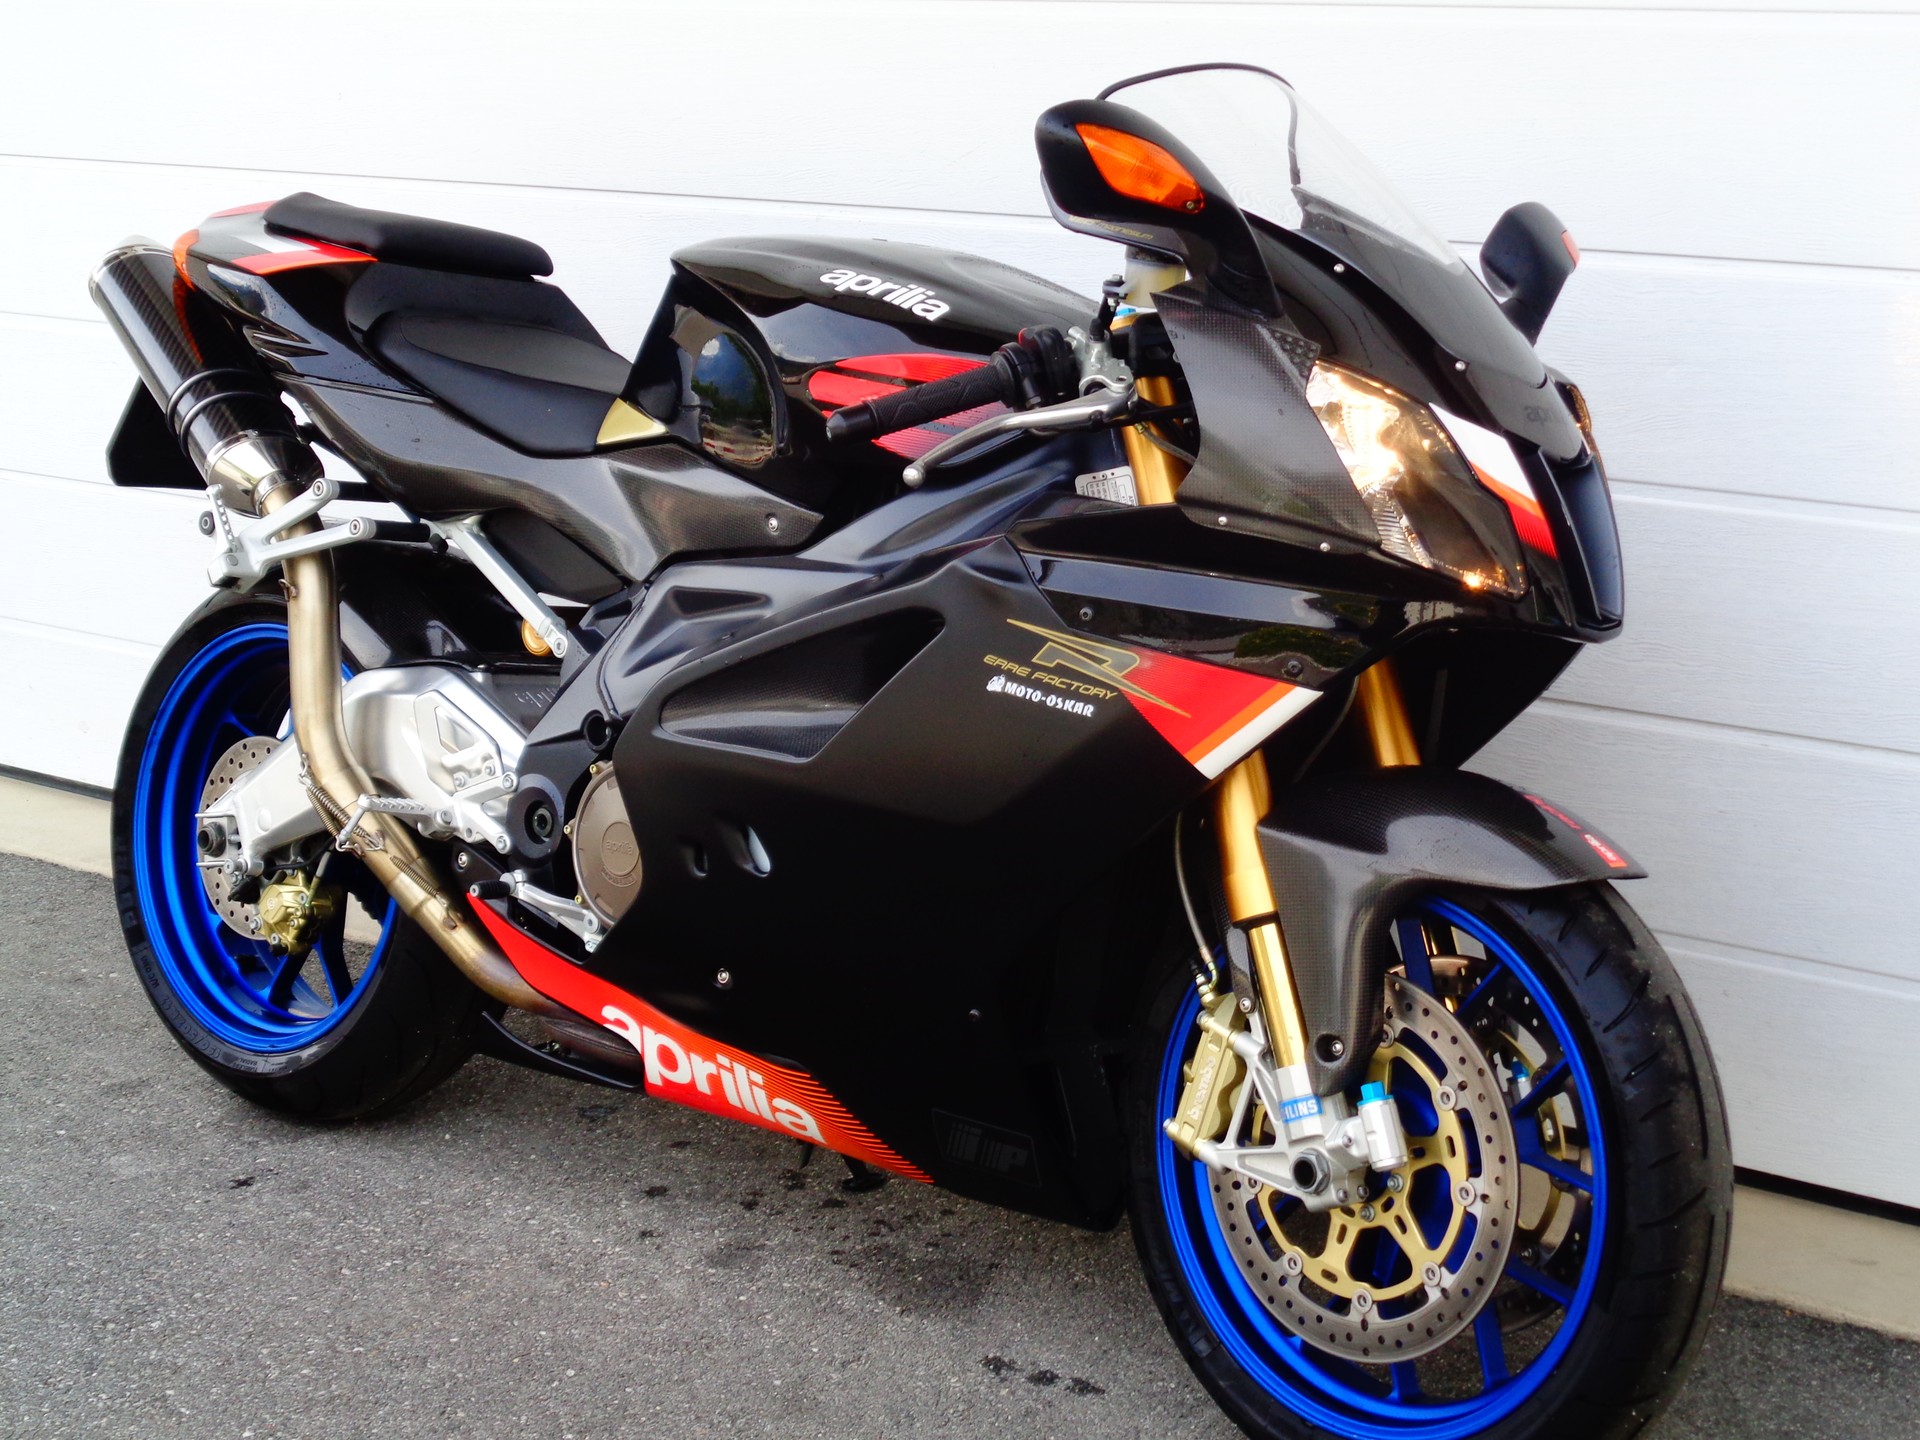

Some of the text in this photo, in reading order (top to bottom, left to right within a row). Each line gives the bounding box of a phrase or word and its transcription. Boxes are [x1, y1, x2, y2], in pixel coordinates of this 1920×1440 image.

[819, 268, 950, 322] aprilia
[1004, 681, 1095, 718] MOTO-OSKAR
[1031, 671, 1118, 700] FACTORY
[601, 1005, 828, 1144] aprilia
[1186, 1055, 1216, 1121] brembo
